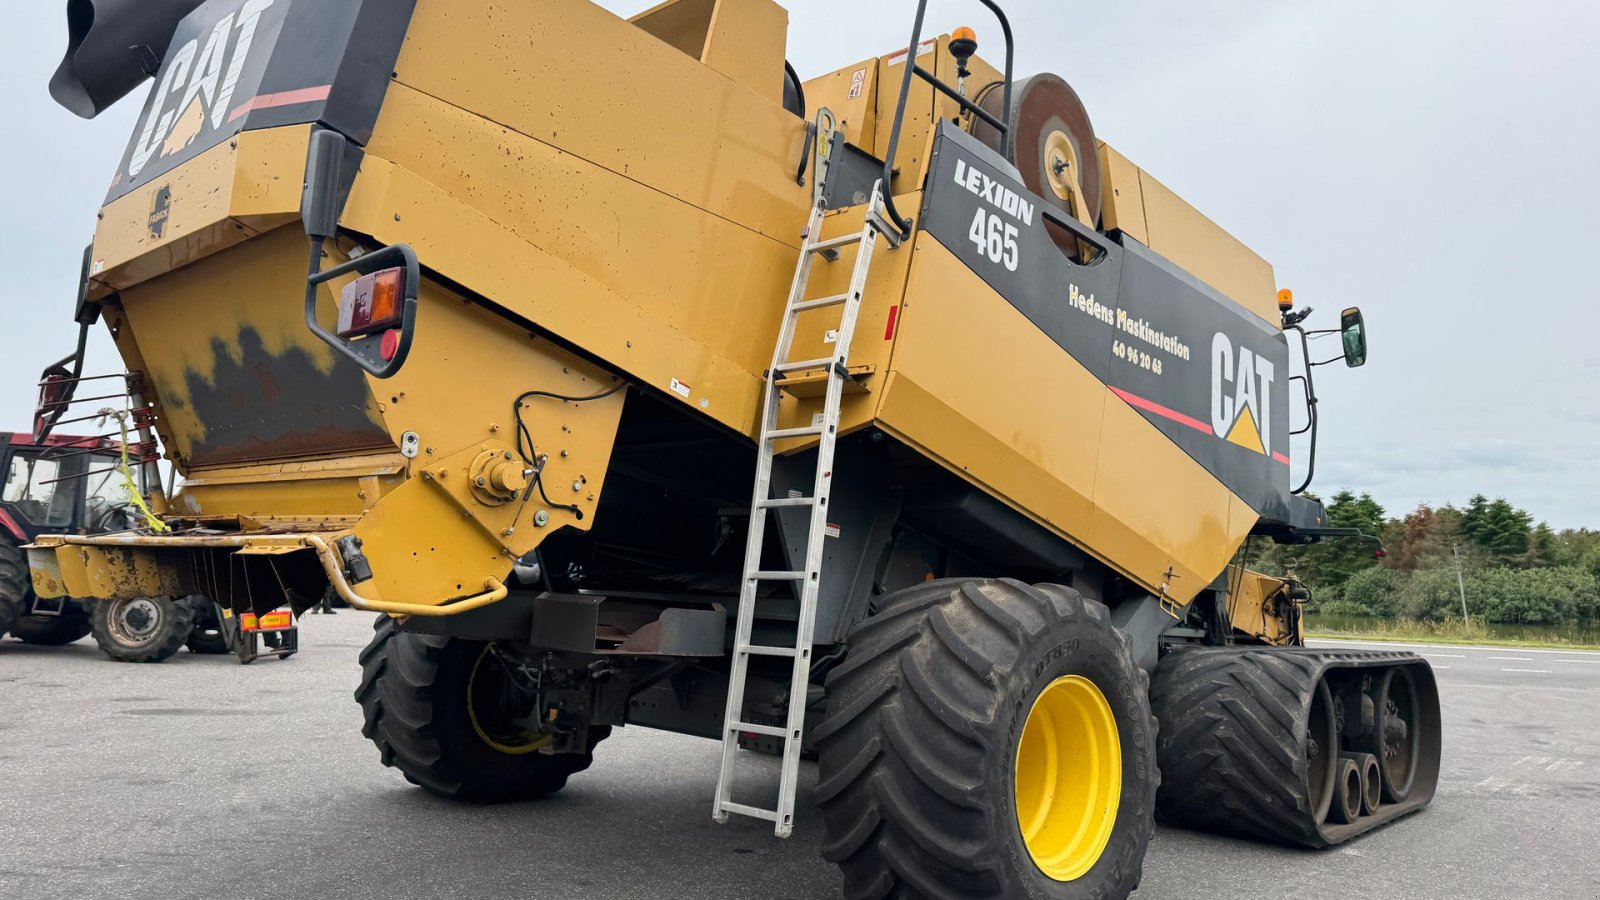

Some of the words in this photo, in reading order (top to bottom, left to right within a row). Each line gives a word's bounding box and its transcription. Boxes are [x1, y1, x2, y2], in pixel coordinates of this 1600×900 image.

[129, 0, 274, 176] CAT
[954, 159, 1034, 226] LEXION
[969, 207, 1018, 271] 465
[1068, 283, 1114, 325] Hedens
[1116, 308, 1190, 360] Maskinstation
[1112, 340, 1126, 359] 40
[1127, 346, 1138, 364] 96
[1140, 352, 1151, 370] 20
[1211, 332, 1274, 456] CAT
